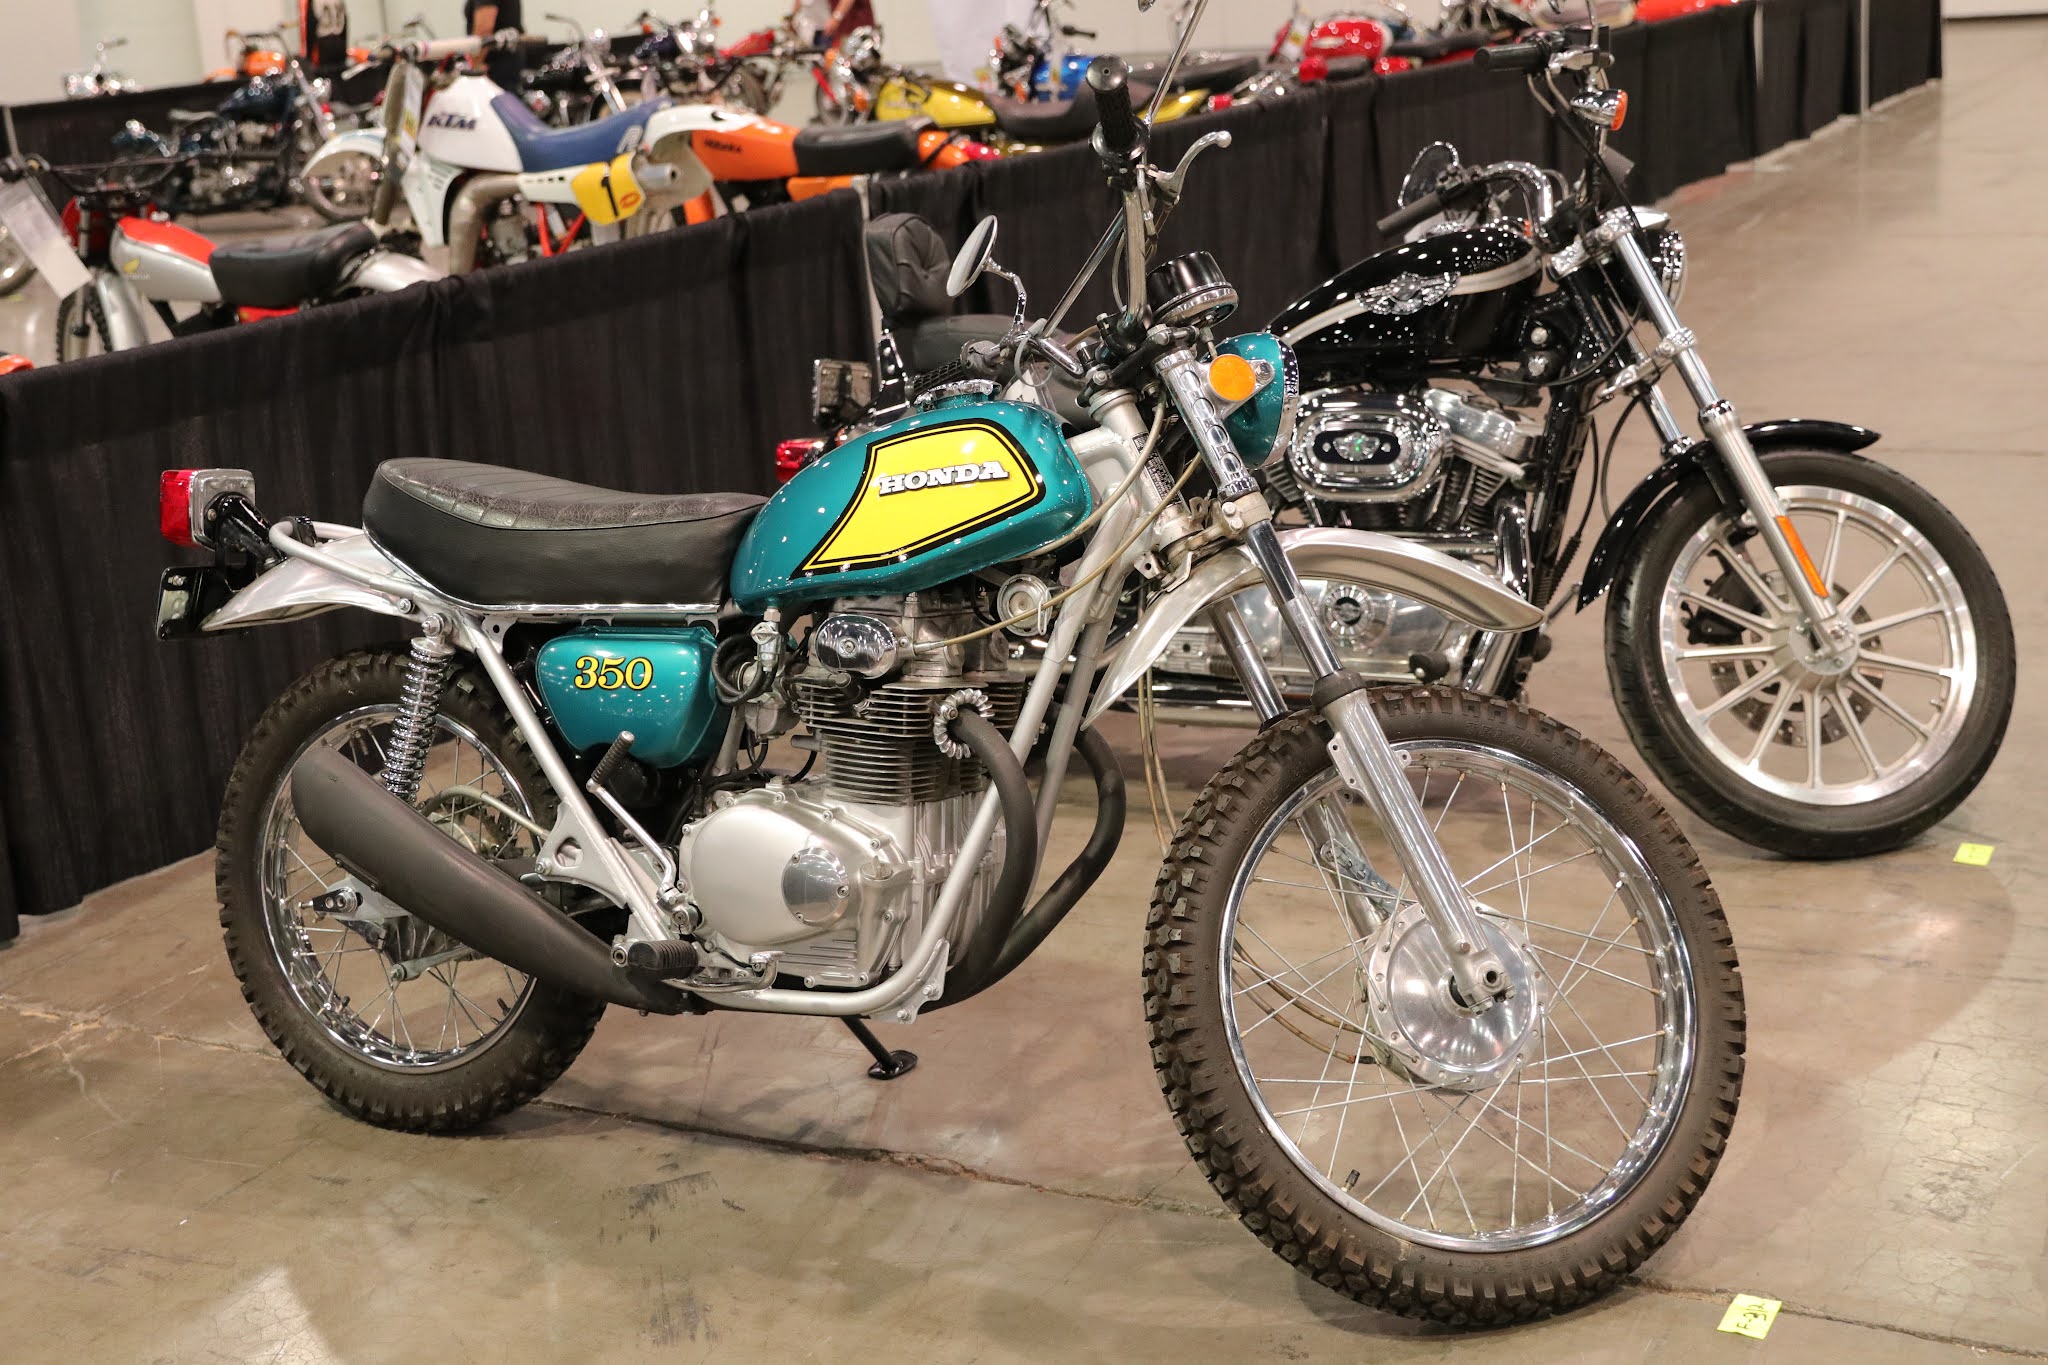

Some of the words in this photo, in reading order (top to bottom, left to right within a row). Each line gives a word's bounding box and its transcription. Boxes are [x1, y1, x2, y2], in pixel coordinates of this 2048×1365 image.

[427, 113, 478, 131] KTM
[878, 460, 1010, 497] HONDA
[573, 654, 654, 692] 350
